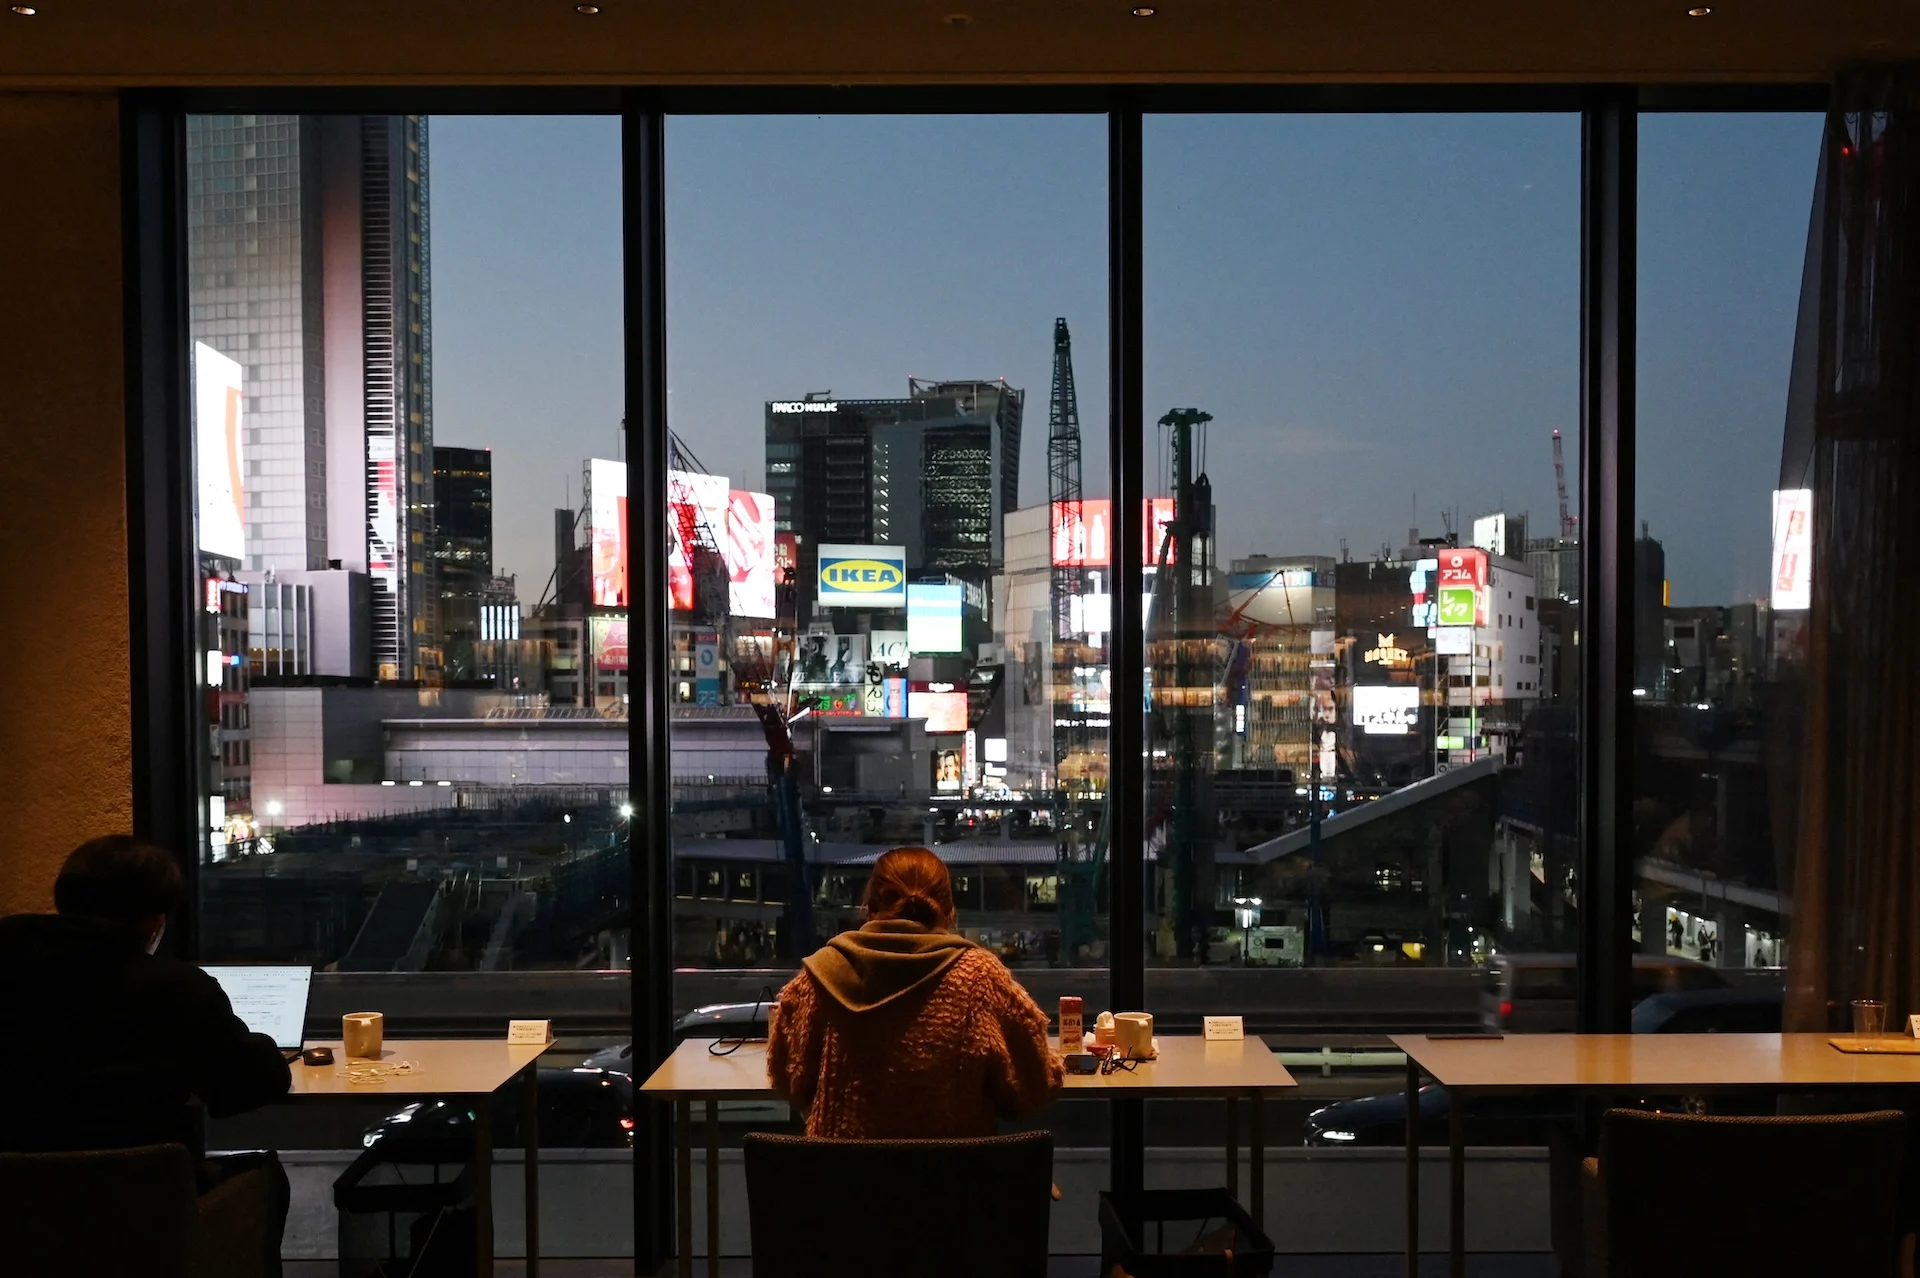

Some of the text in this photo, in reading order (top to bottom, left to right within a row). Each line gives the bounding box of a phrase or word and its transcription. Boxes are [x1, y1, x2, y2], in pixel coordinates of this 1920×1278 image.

[772, 402, 804, 414] PARCO
[829, 568, 897, 583] IKEA
[1442, 569, 1472, 580] アコム
